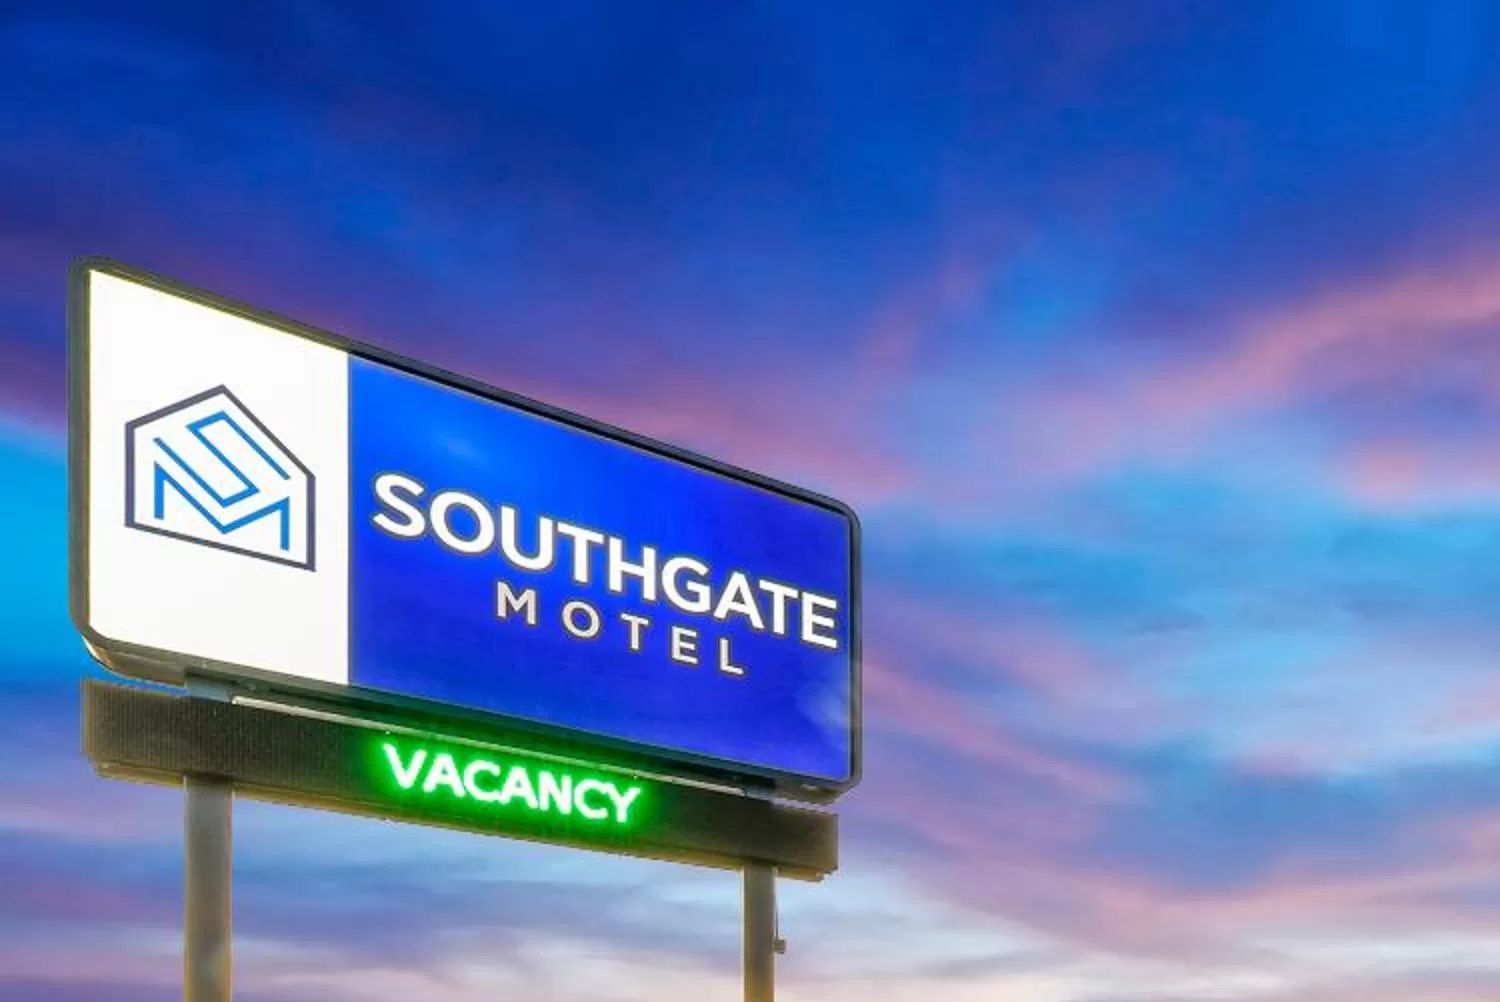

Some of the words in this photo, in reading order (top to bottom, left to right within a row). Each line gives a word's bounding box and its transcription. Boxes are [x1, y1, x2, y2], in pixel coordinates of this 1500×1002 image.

[372, 472, 839, 649] SOUTHGATE
[496, 580, 745, 676] MOTEL
[383, 743, 641, 825] VACANCY
